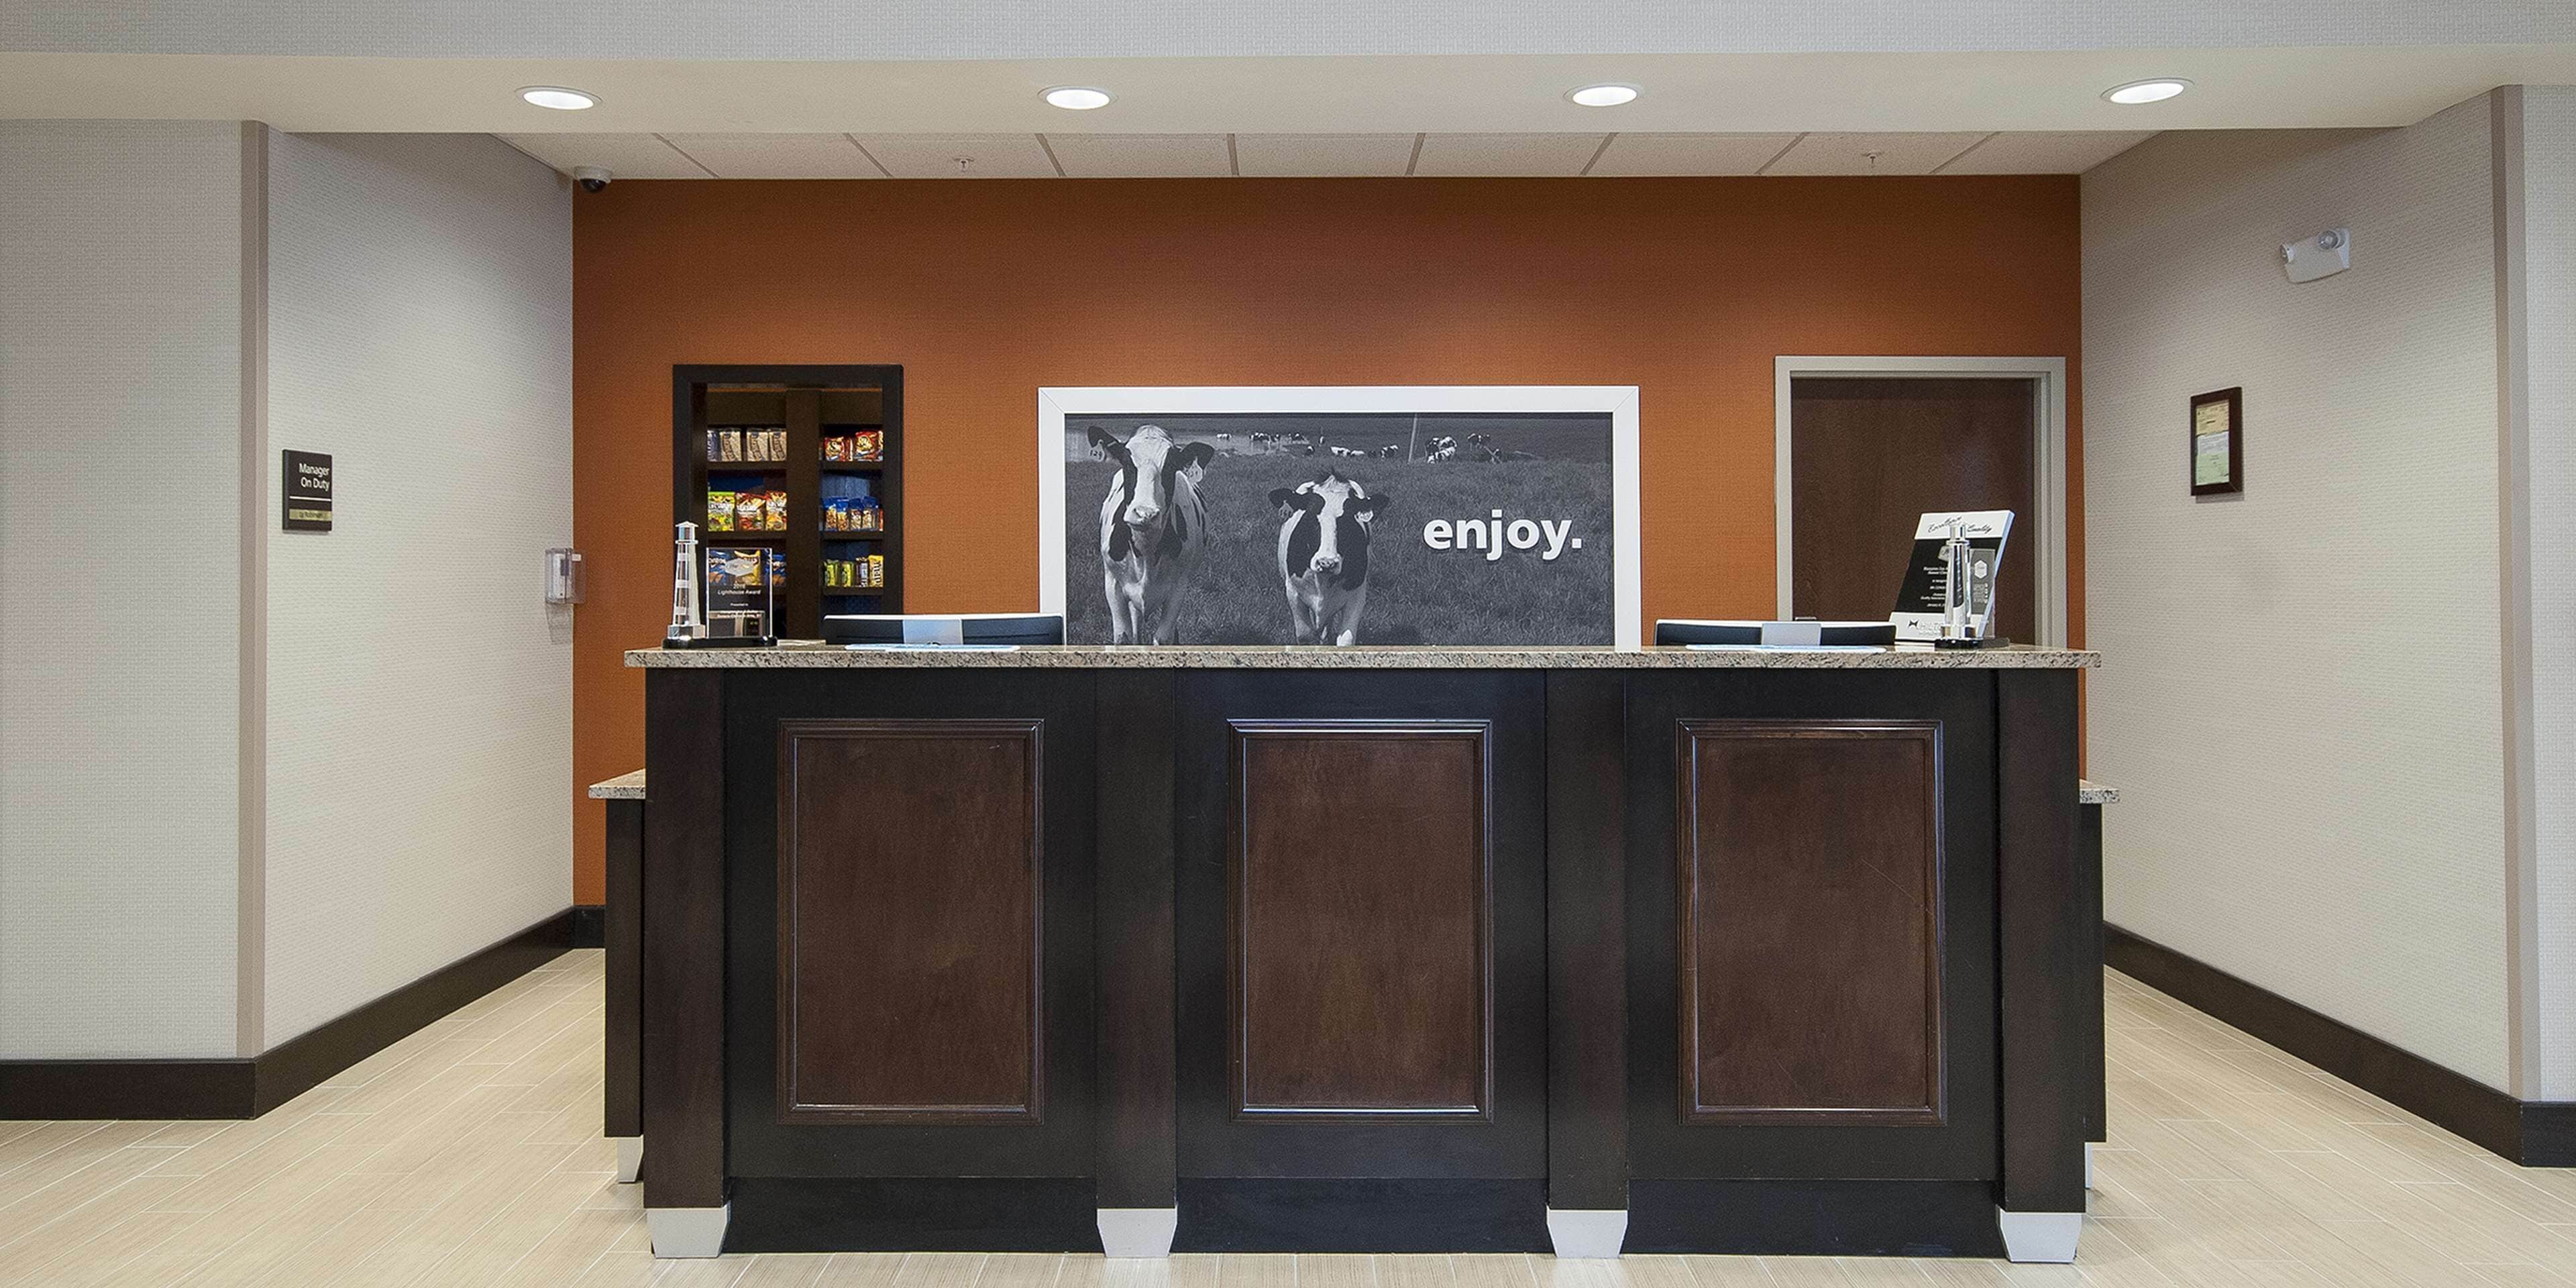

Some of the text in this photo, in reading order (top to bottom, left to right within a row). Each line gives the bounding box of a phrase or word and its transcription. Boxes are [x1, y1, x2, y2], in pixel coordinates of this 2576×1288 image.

[299, 463, 329, 477] Manager
[301, 477, 329, 491] On Duty
[1423, 509, 1582, 561] enjoy.
